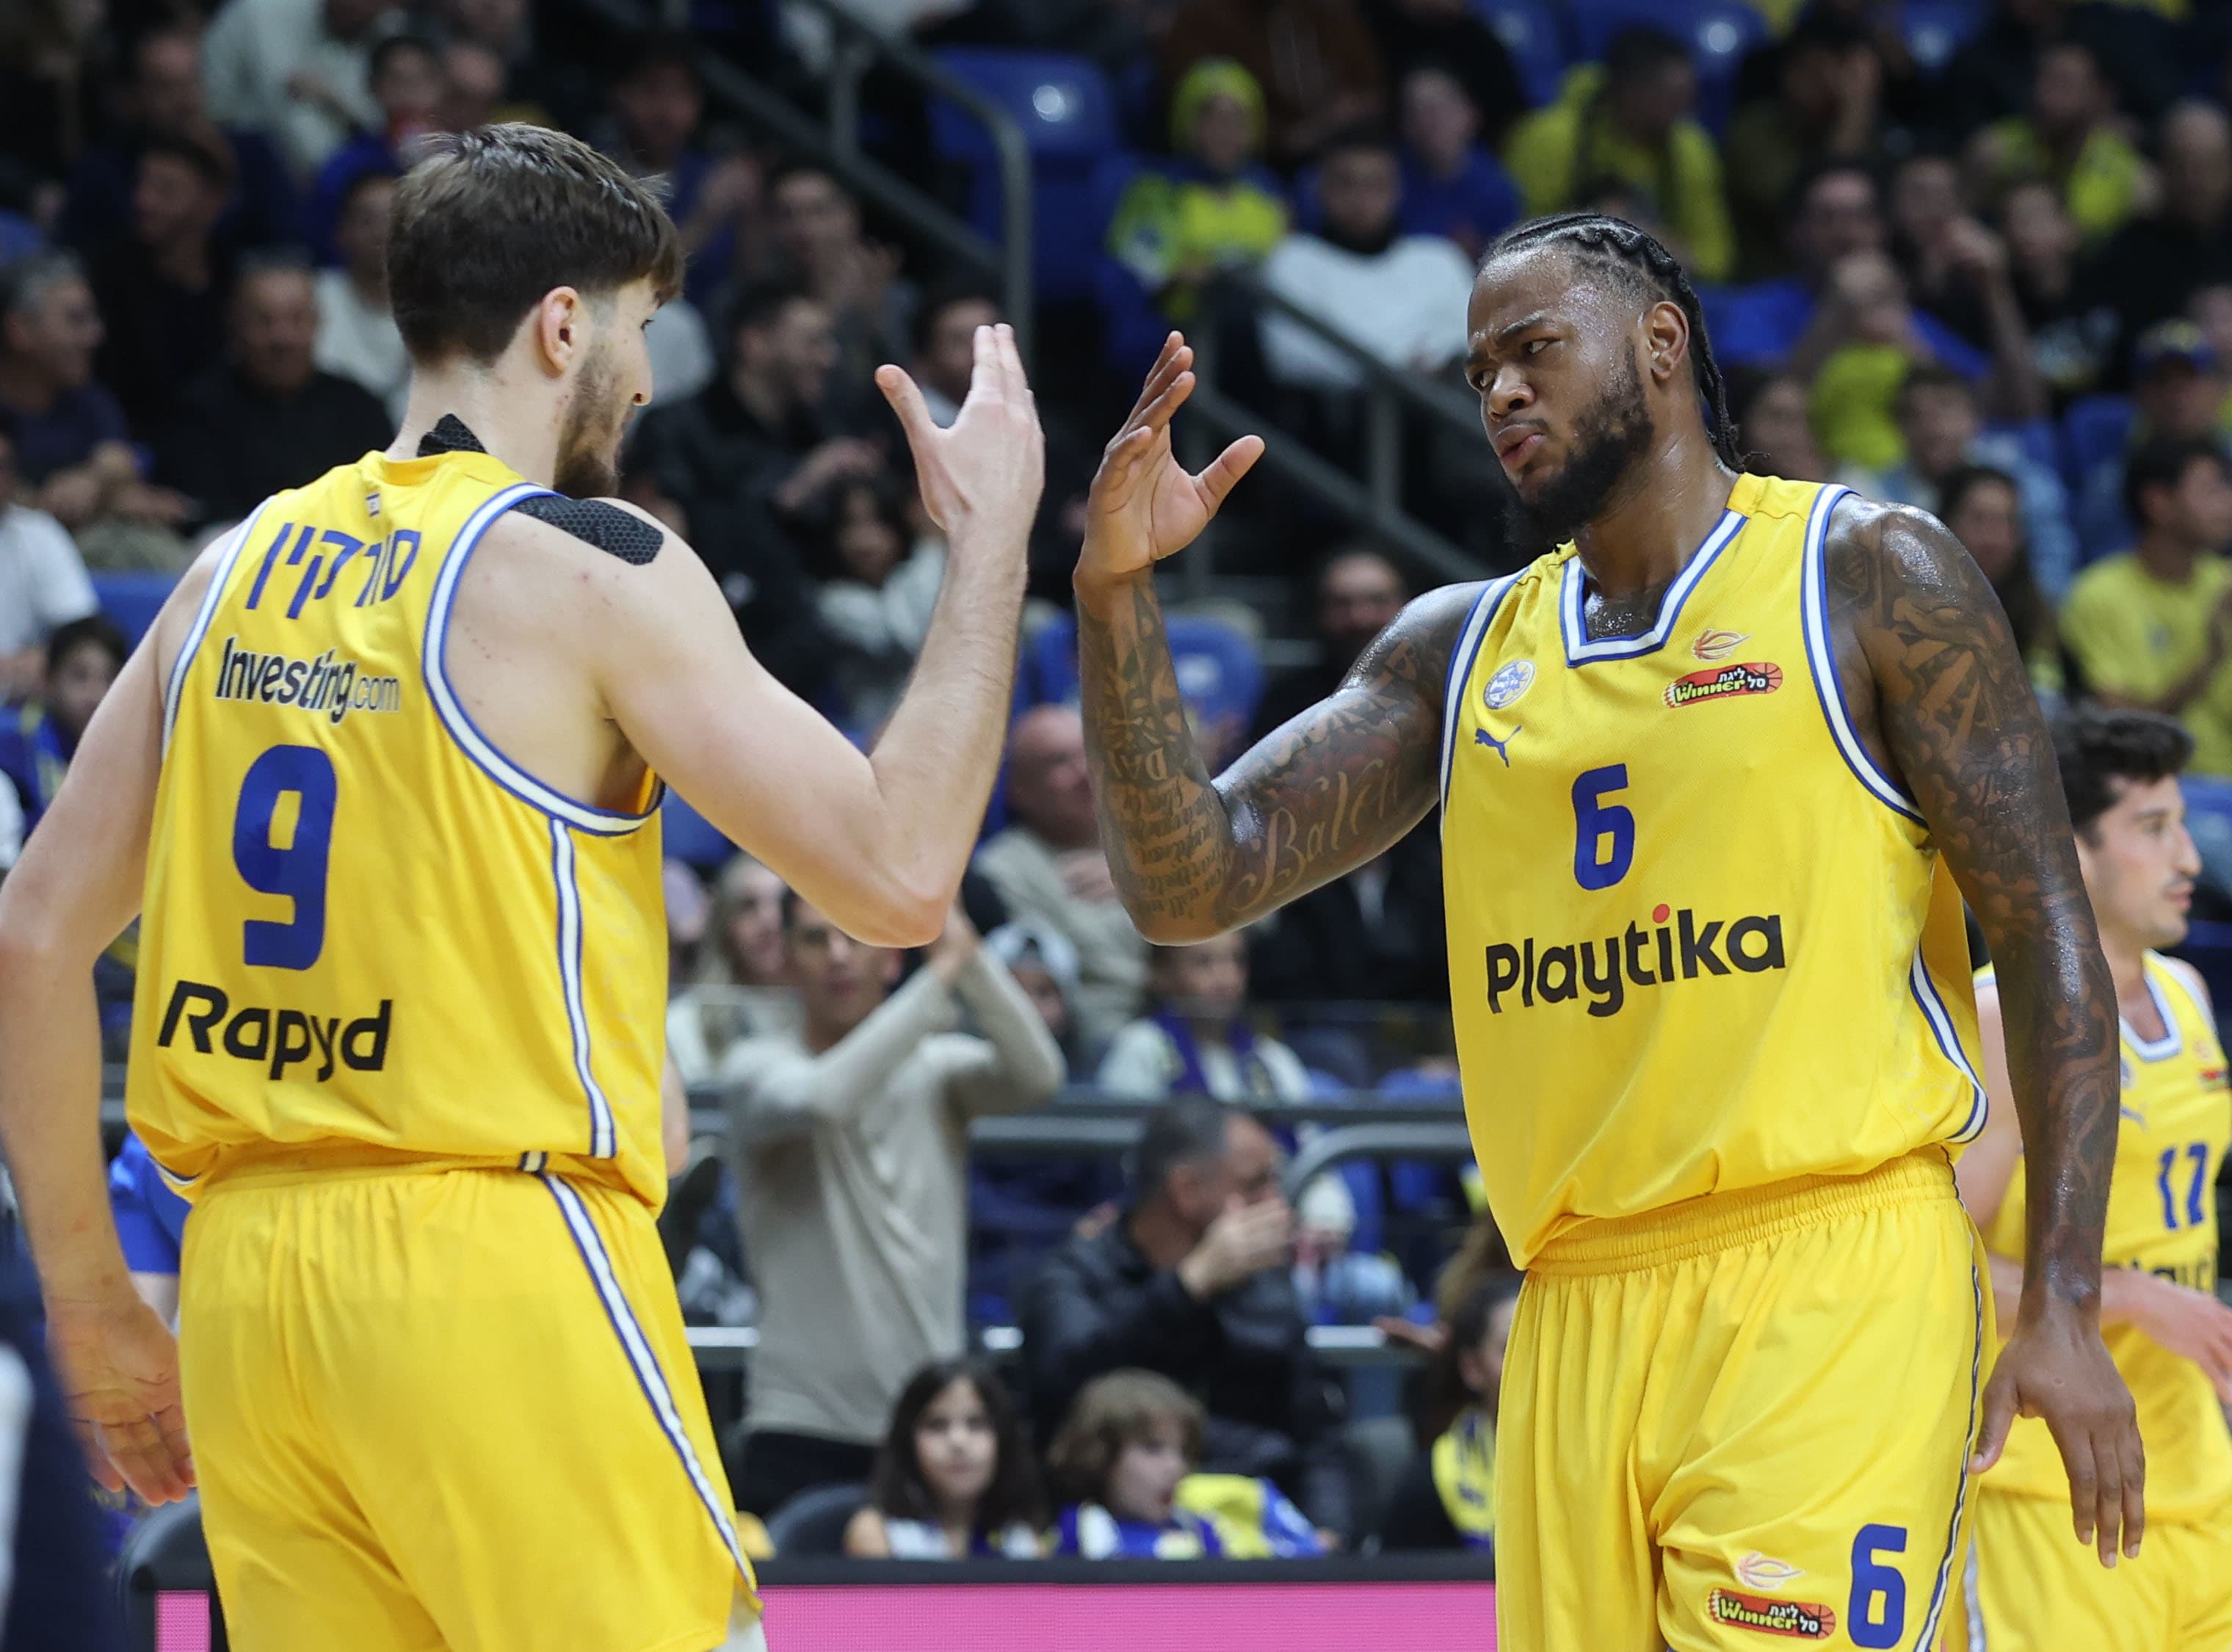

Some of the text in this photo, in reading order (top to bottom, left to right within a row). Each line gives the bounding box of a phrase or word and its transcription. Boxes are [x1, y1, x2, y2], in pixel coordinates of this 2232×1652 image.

[215, 637, 400, 723] Investing.com
[1676, 676, 1766, 702] Winner סל
[1718, 667, 1745, 683] ליגת
[232, 745, 337, 971] 9
[1572, 762, 1635, 891] 6
[1485, 903, 1786, 1017] Playtika
[158, 980, 393, 1082] Rapyd
[1719, 1598, 1819, 1633] Winner סל
[1769, 1604, 1799, 1618] ליגת
[1848, 1524, 1907, 1650] 6
